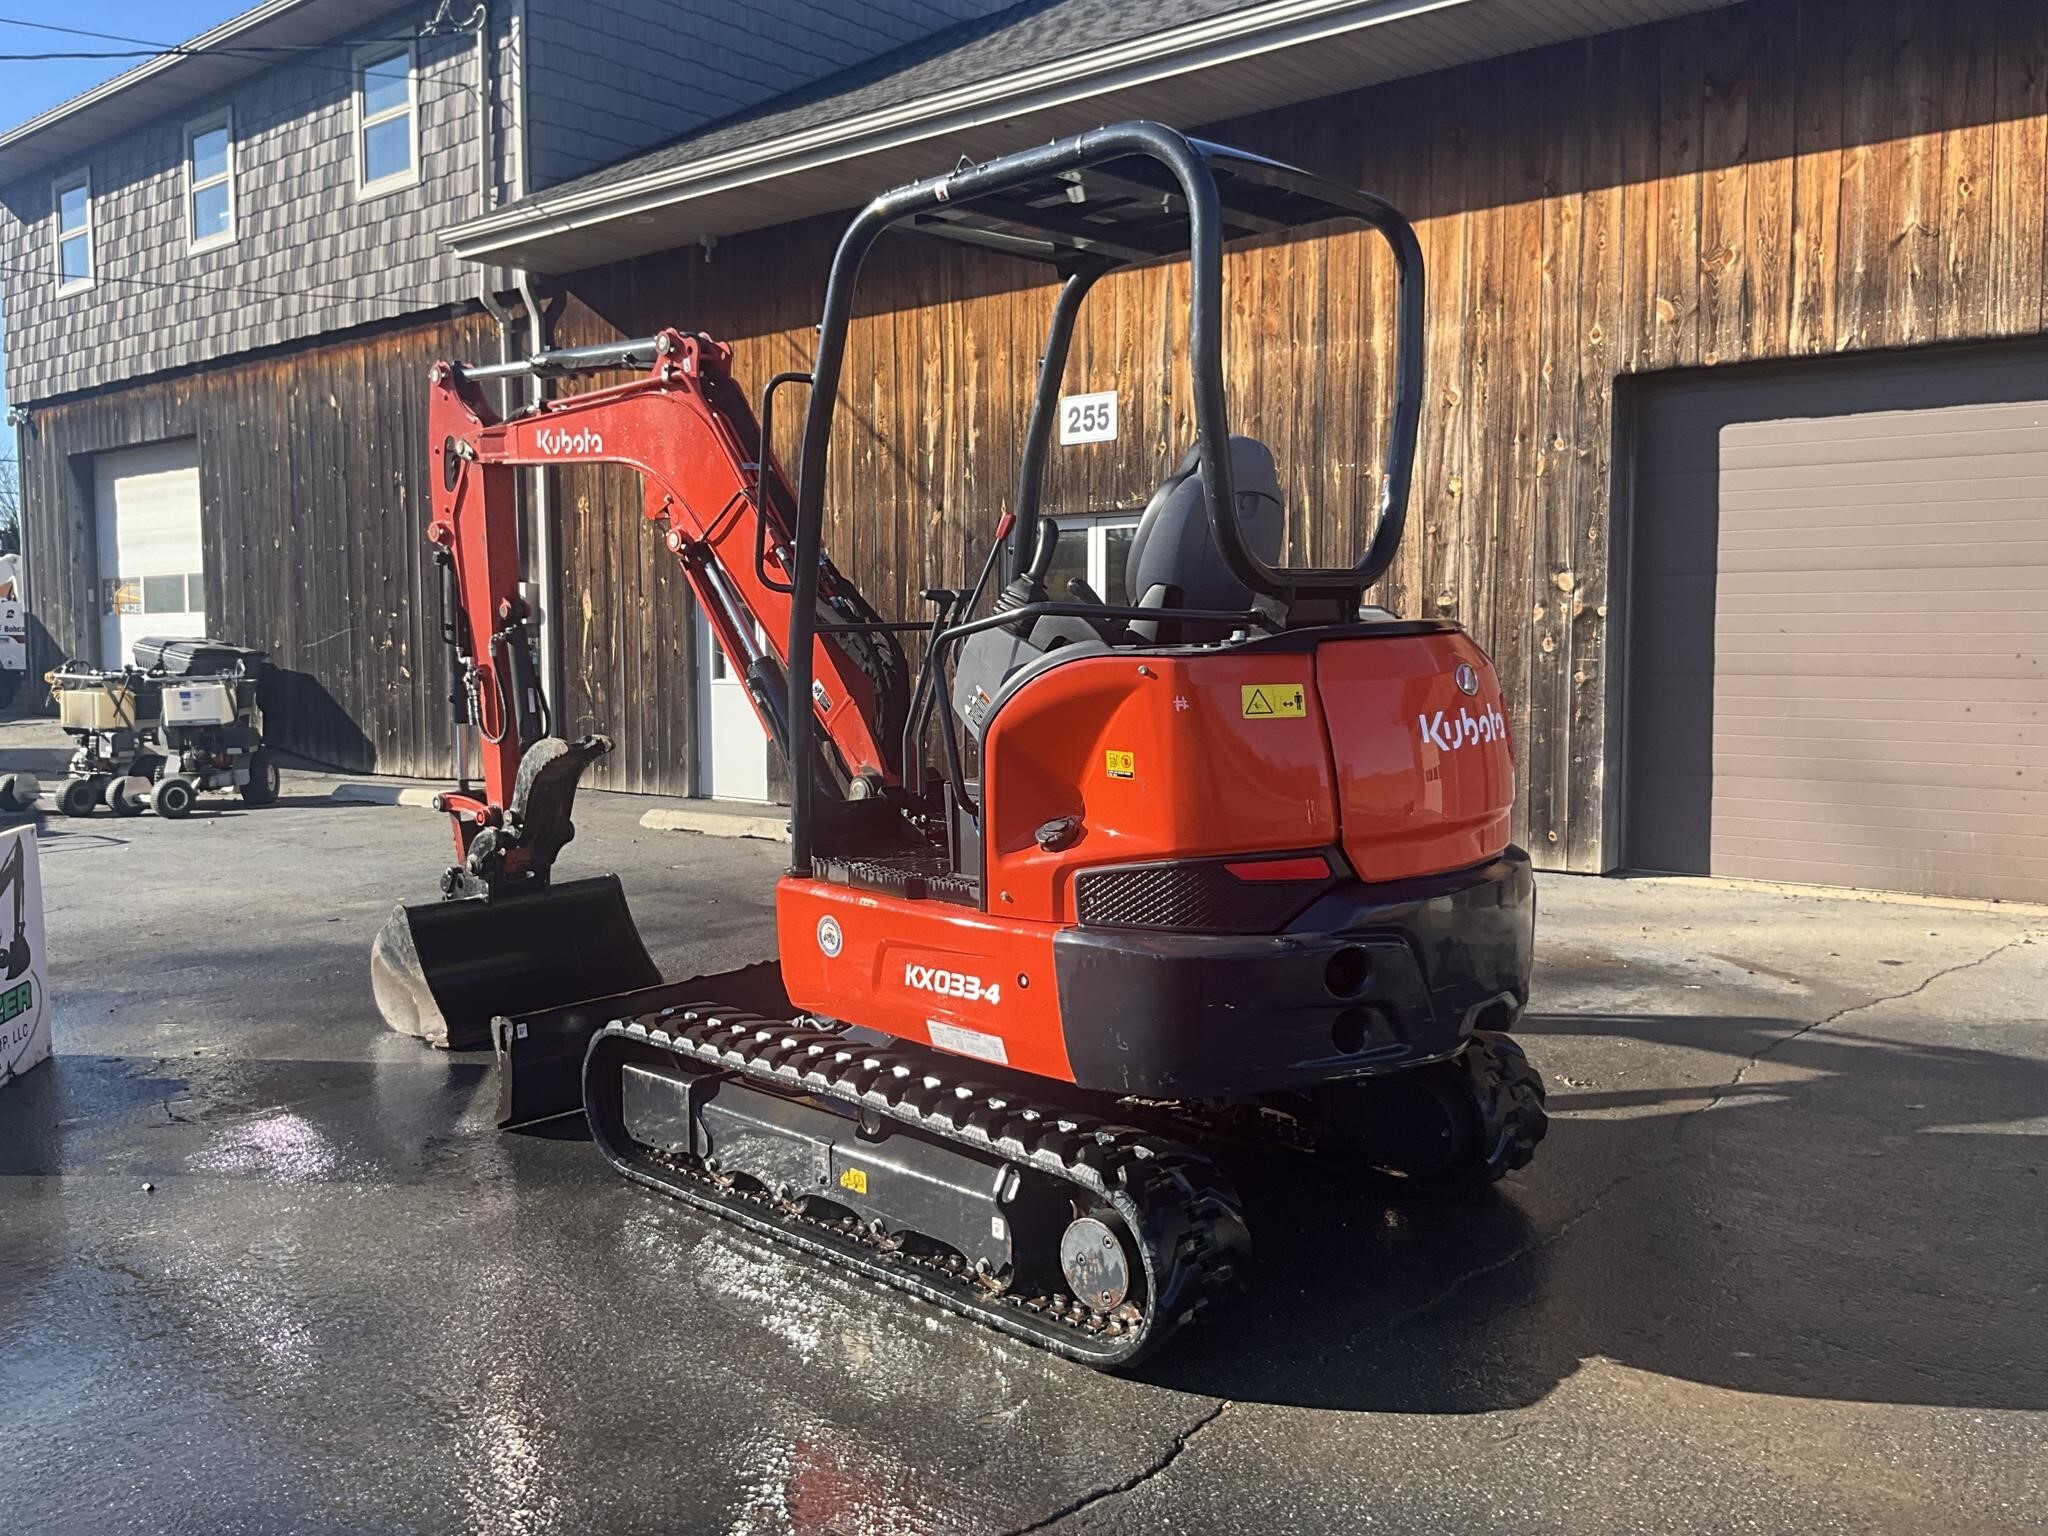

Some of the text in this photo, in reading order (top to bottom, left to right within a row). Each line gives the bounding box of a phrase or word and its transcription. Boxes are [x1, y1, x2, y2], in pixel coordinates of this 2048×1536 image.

[1067, 402, 1110, 434] 255
[536, 426, 603, 455] Kubota
[1418, 702, 1506, 751] Kubota
[904, 963, 1001, 1006] KX033-4
[12, 1023, 29, 1044] LLC
